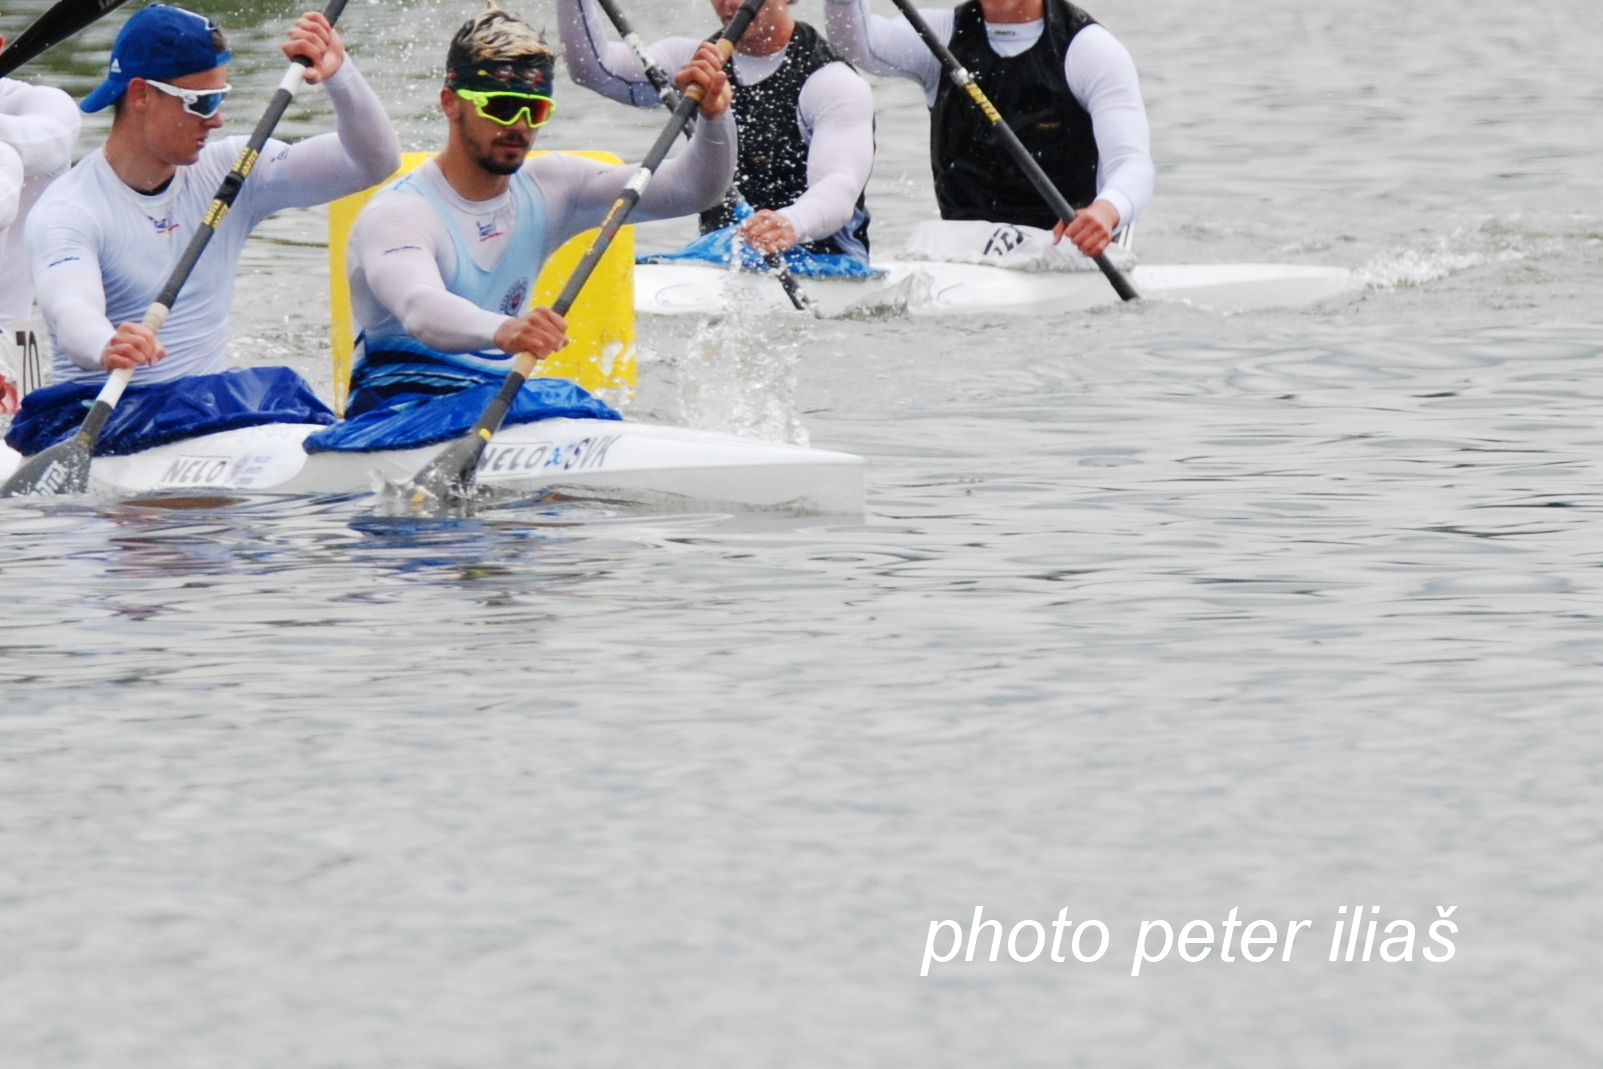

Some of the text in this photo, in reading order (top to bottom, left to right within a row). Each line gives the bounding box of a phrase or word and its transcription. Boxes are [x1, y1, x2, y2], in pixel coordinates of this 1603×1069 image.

[478, 435, 623, 472] NELO SVK
[161, 458, 228, 483] NELO
